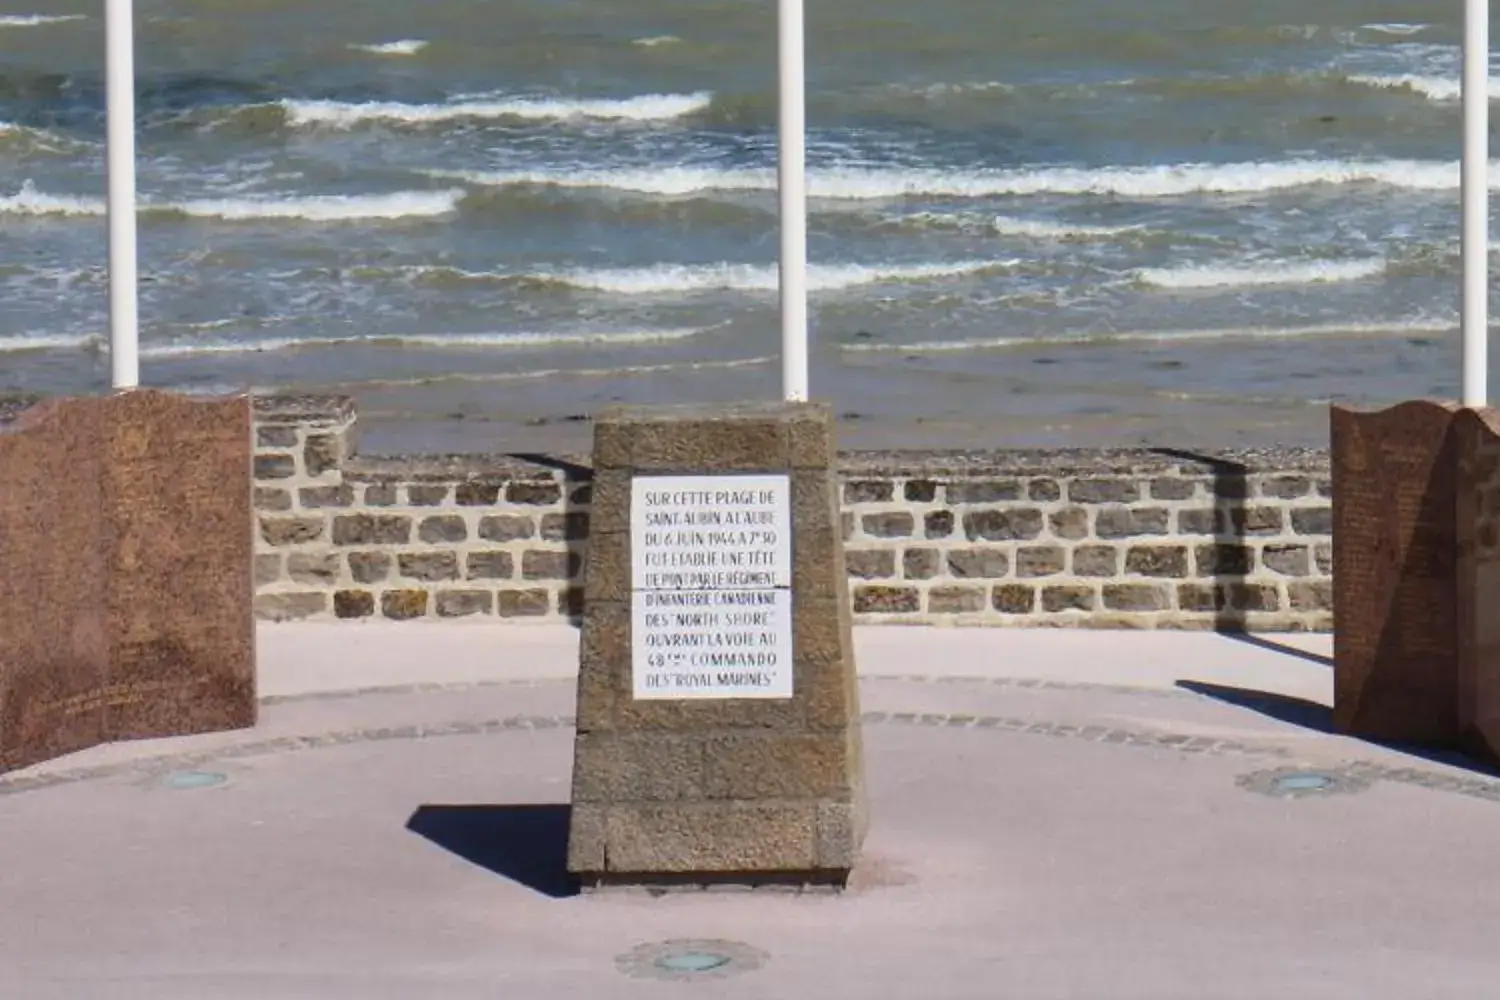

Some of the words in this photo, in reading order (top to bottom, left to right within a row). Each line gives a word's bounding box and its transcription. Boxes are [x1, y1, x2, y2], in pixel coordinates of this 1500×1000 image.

[645, 491, 671, 505] SUR
[673, 491, 712, 505] CETTE
[715, 491, 756, 505] PLAGE
[759, 491, 775, 505] DE
[645, 532, 662, 546] DU
[664, 532, 673, 545] 6
[675, 532, 703, 546] JUIN
[708, 532, 735, 546] 1944
[645, 552, 668, 566] FUT
[721, 552, 744, 566] UNE
[645, 572, 658, 586] DE
[660, 572, 688, 586] PONT
[690, 572, 711, 586] PAR
[712, 572, 725, 586] LE
[713, 592, 776, 606] CANADIENNE
[645, 613, 669, 627] DES
[645, 632, 706, 647] OUVRANT
[707, 632, 723, 647] LA
[725, 632, 754, 647] VOIE
[759, 632, 777, 647] AU
[690, 652, 777, 667] COMMANDO
[646, 672, 670, 688] DES
